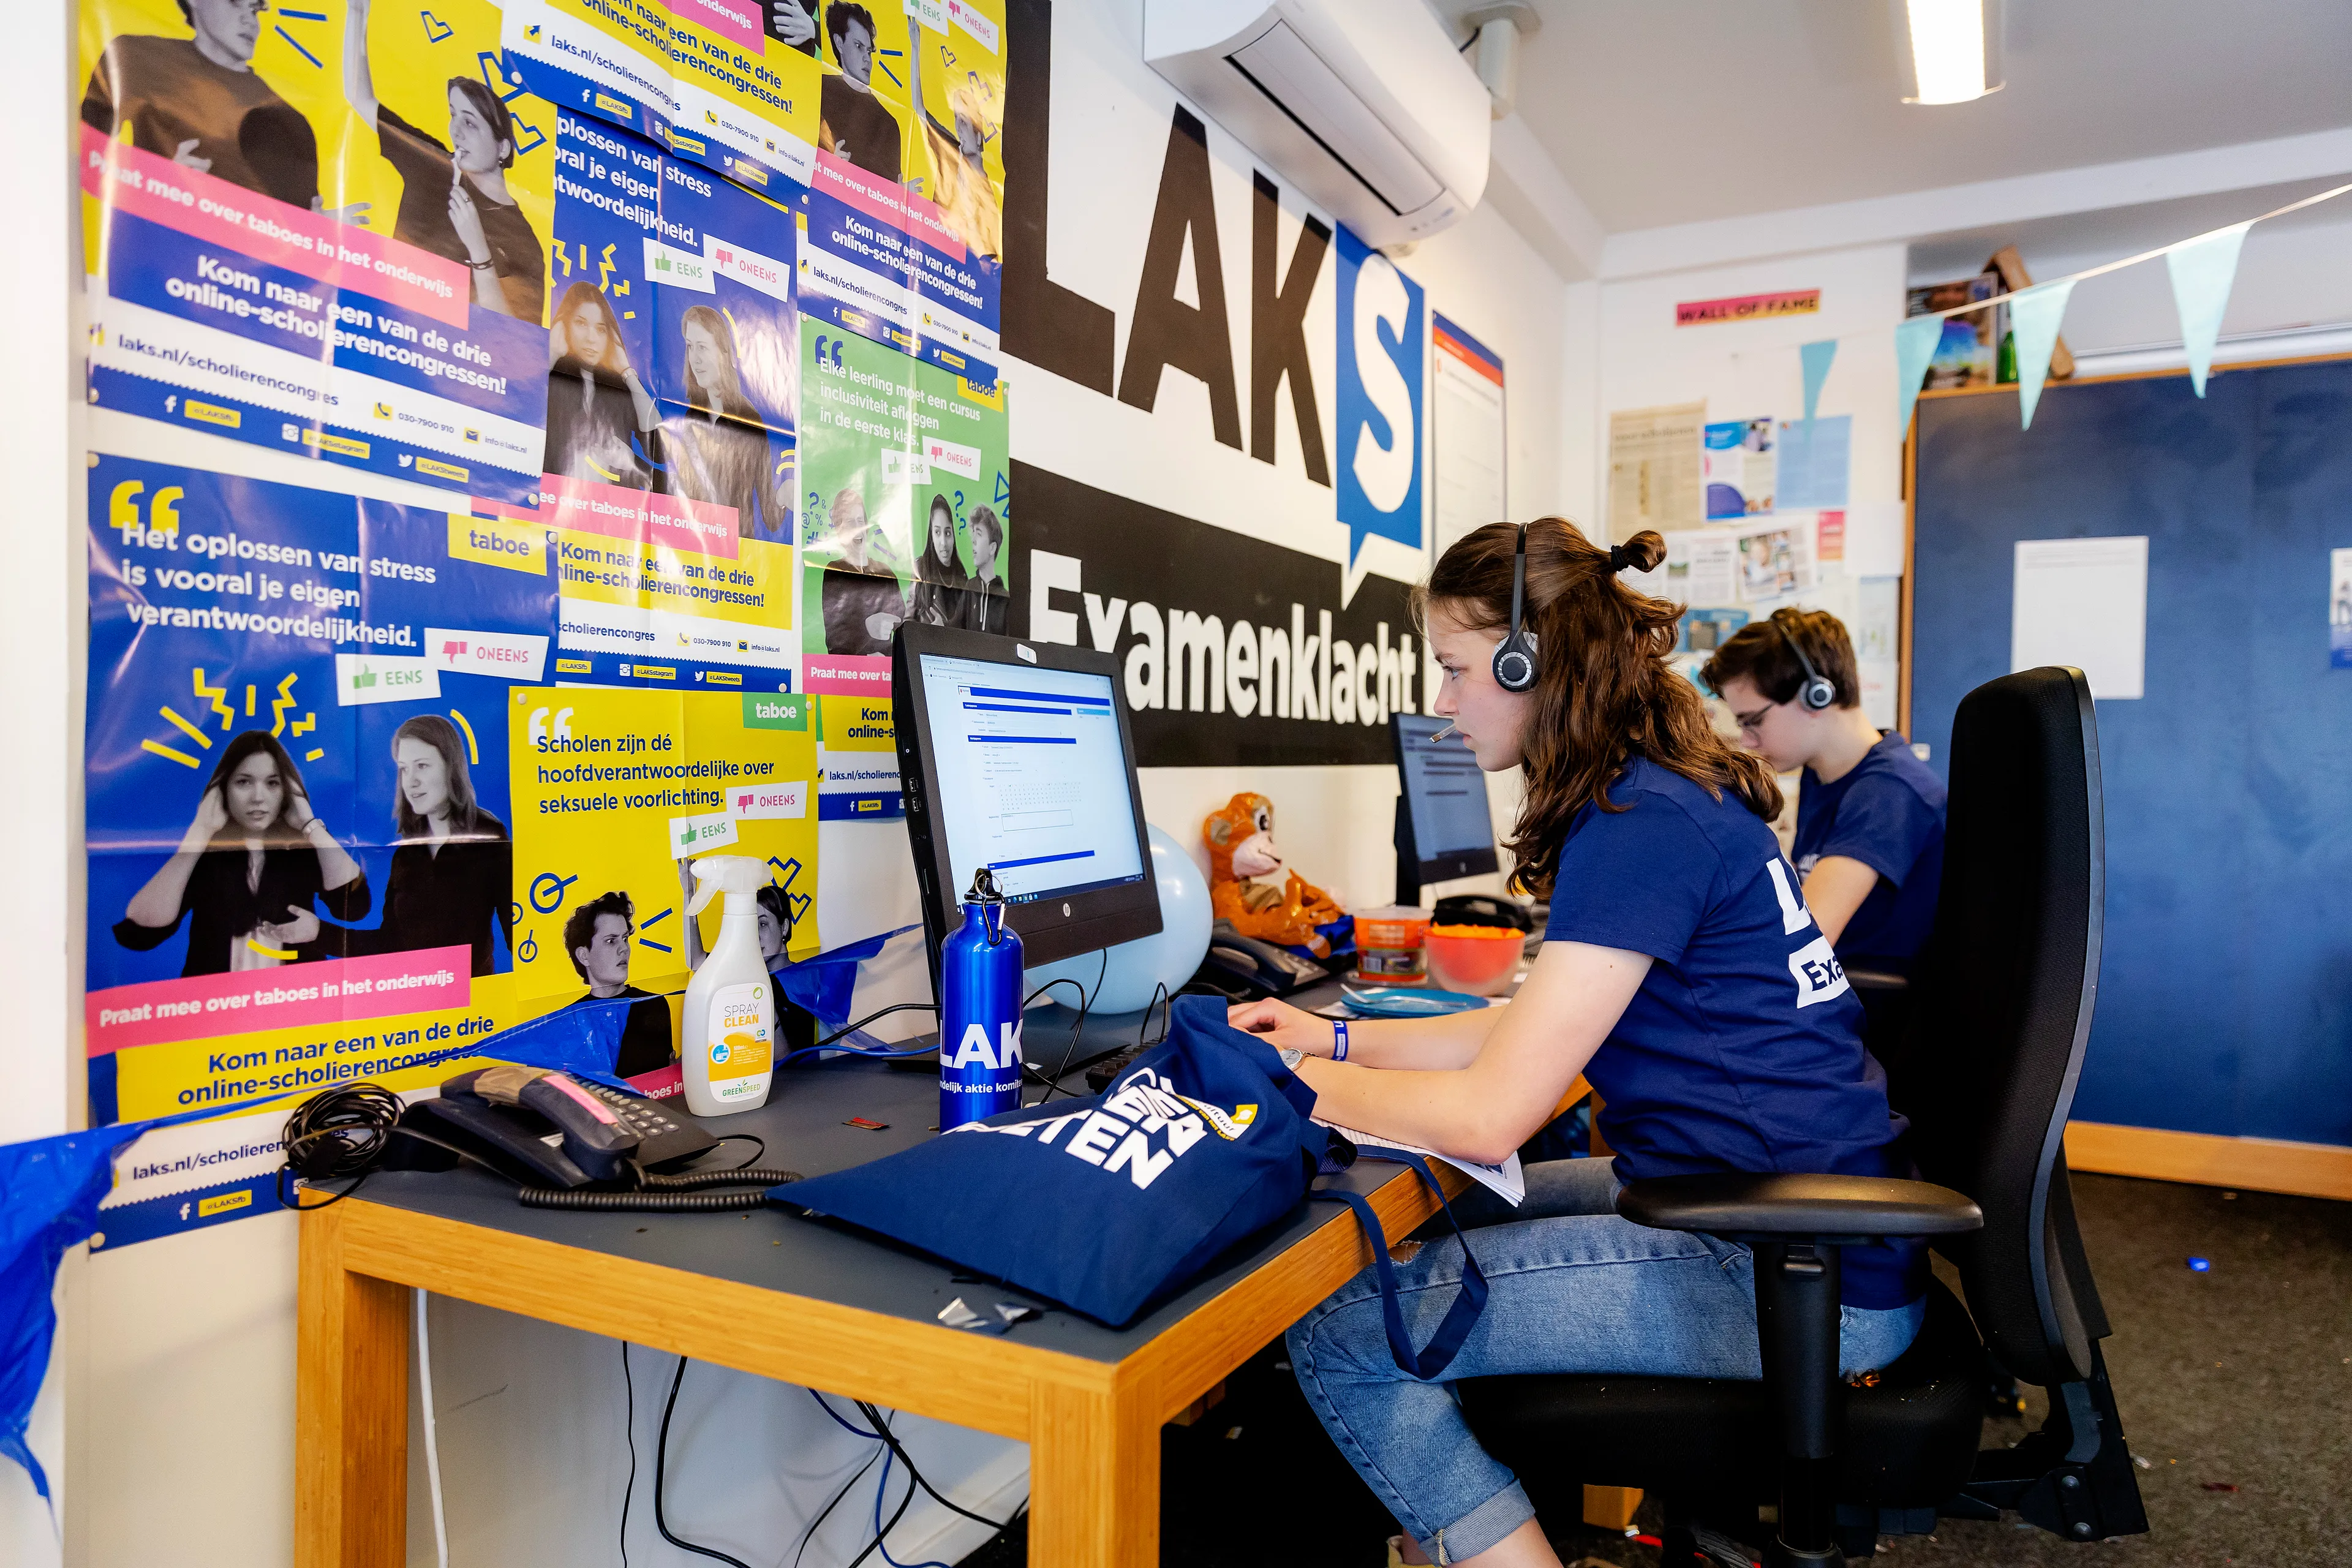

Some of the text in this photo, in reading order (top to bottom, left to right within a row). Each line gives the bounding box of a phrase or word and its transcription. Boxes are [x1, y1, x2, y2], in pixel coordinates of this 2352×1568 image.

[922, 4, 941, 21] EENS
[965, 13, 990, 39] ONEENS
[582, 0, 793, 115] online-scholierencongressen!
[636, 4, 667, 32] naar
[669, 26, 698, 48] een
[702, 40, 729, 64] van
[733, 54, 752, 74] de
[755, 65, 782, 89] drie
[551, 34, 681, 111] laks.nl/scholierencongres
[721, 120, 760, 143] 030-7900 910
[556, 115, 712, 198] plossen van stress
[778, 148, 805, 167] info@laks.nl
[554, 145, 660, 202] oral je eigen
[553, 173, 698, 247] twoordelijkheid.
[823, 168, 960, 243] mee over taboes in het onderwijs
[146, 178, 195, 206] mee
[198, 198, 244, 225] over
[247, 214, 314, 250] taboes
[317, 238, 333, 257] in
[338, 240, 371, 269] het
[374, 260, 453, 298] onderwijs
[845, 215, 977, 290] Kom naar een van de drie
[1000, 0, 1414, 513] LAKS
[676, 262, 703, 279] EENS
[739, 260, 777, 284] ONEENS
[831, 230, 984, 309] online-scholierencongressen!
[813, 266, 908, 315] laks.nl/scholierencongres
[197, 255, 492, 367] Kom naar een van de drie
[165, 277, 508, 394] online-scholierencongressen!
[118, 334, 339, 405] laks.nl/scholierencongres
[820, 357, 981, 421] Elke leerling moet een cursus
[820, 382, 889, 417] inclusiviteit
[398, 412, 454, 434] 030-7900 910
[820, 407, 832, 424] in
[835, 412, 851, 429] de
[854, 419, 891, 439] eerste
[484, 435, 527, 454] info@laks.nl
[946, 452, 972, 467] ONEENS
[538, 491, 556, 505] ee
[590, 499, 635, 519] taboes
[638, 508, 649, 522] in
[650, 511, 671, 527] het
[122, 521, 437, 584] Het oplossen van stress
[469, 529, 530, 556] taboe
[561, 540, 601, 564] Kom
[606, 550, 643, 570] naar
[708, 565, 725, 583] de
[728, 569, 755, 588] drie
[122, 559, 361, 608] is vooral je eigen
[558, 563, 765, 608] nline-scholierencongressen!
[126, 602, 417, 647] verantwoordelijkheid.
[558, 621, 656, 643] scholierencongres
[476, 646, 529, 664] ONEENS
[693, 637, 721, 647] 030-7900
[751, 643, 780, 654] info@laks.nl
[385, 669, 423, 686] EENS
[560, 662, 588, 671] @LAKSfb
[709, 674, 741, 682] @LAKStweets
[810, 666, 880, 680] Praat mee over
[755, 702, 797, 720] taboe
[861, 707, 888, 721] Kom
[537, 733, 673, 755] Scholen zijn dé
[848, 725, 894, 738] online-s
[537, 760, 774, 784] hoofdverantwoordelijke over
[829, 770, 900, 780] laks.nl/scholierenc
[539, 788, 724, 814] seksuele voorlichting.
[760, 794, 796, 808] ONEENS
[701, 821, 726, 839] EENS
[1800, 955, 1843, 992] Exa
[100, 970, 454, 1028] Praat mee over taboes in het onderwijs
[724, 1002, 760, 1017] SPRAY
[724, 1014, 759, 1028] CLEAN
[208, 1015, 494, 1074] Kom naar een van de drie
[644, 1080, 683, 1099] boes in
[722, 1084, 761, 1096] GREENSPEED
[965, 1079, 1022, 1093] aktie komite
